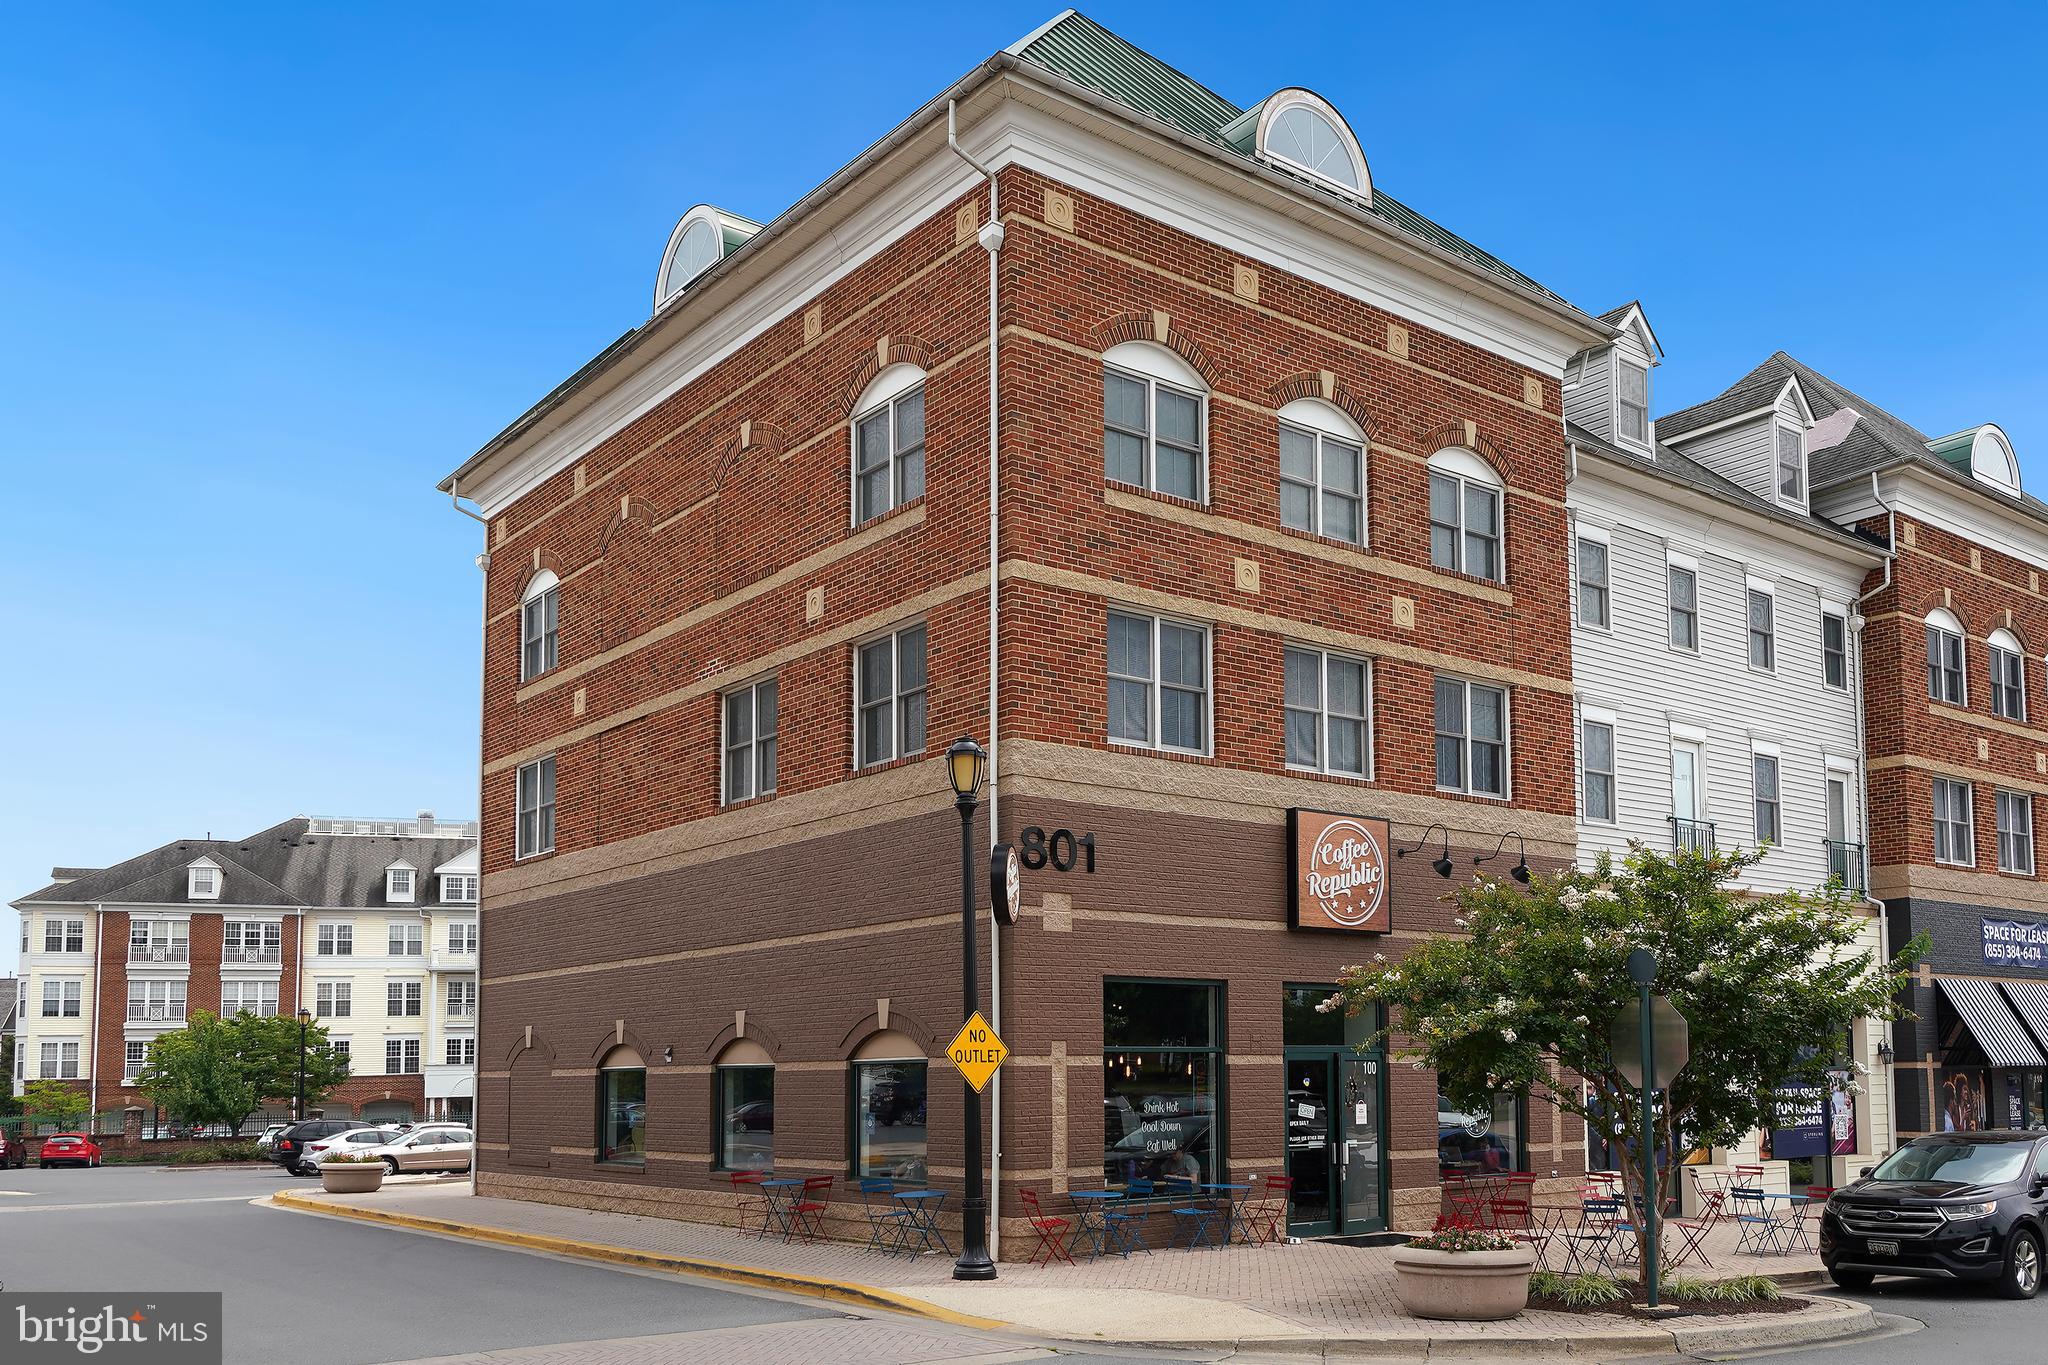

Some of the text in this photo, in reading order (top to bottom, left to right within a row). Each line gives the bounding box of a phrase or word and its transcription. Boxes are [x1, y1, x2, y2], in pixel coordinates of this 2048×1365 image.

[1021, 826, 1095, 872] 801
[1318, 838, 1371, 870] Coffee
[1306, 862, 1382, 898] Republic
[1983, 925, 2010, 941] SPACE
[2010, 927, 2027, 943] FOR
[1985, 943, 2041, 960] (855) 384-6474
[969, 1029, 986, 1043] NO
[955, 1049, 1000, 1063] OUTLET
[1363, 1061, 1377, 1075] 100
[1143, 1100, 1180, 1114] Drink Hot
[1141, 1120, 1181, 1133] Cool Down
[1146, 1138, 1177, 1154] Eat Well
